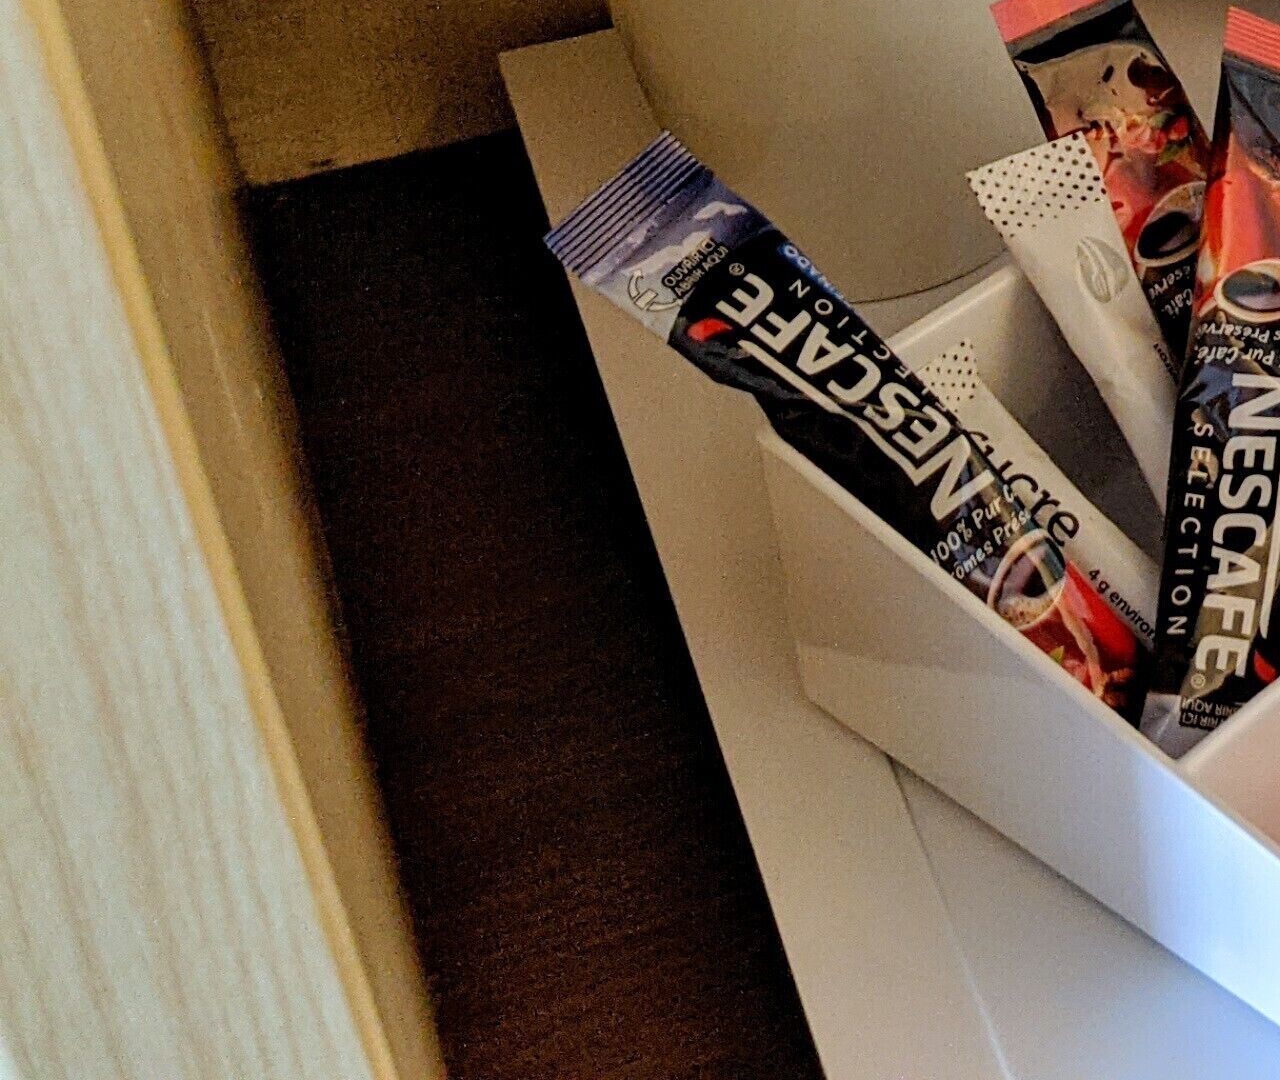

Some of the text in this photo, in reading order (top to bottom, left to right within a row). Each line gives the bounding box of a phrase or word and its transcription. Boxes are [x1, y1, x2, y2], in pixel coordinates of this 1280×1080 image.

[700, 244, 729, 272] AQUI
[1241, 347, 1274, 365] Pur
[970, 494, 1006, 529] Pur
[1165, 421, 1214, 637] SELECTION
[1086, 566, 1102, 582] 4
[1094, 578, 1111, 595] g
